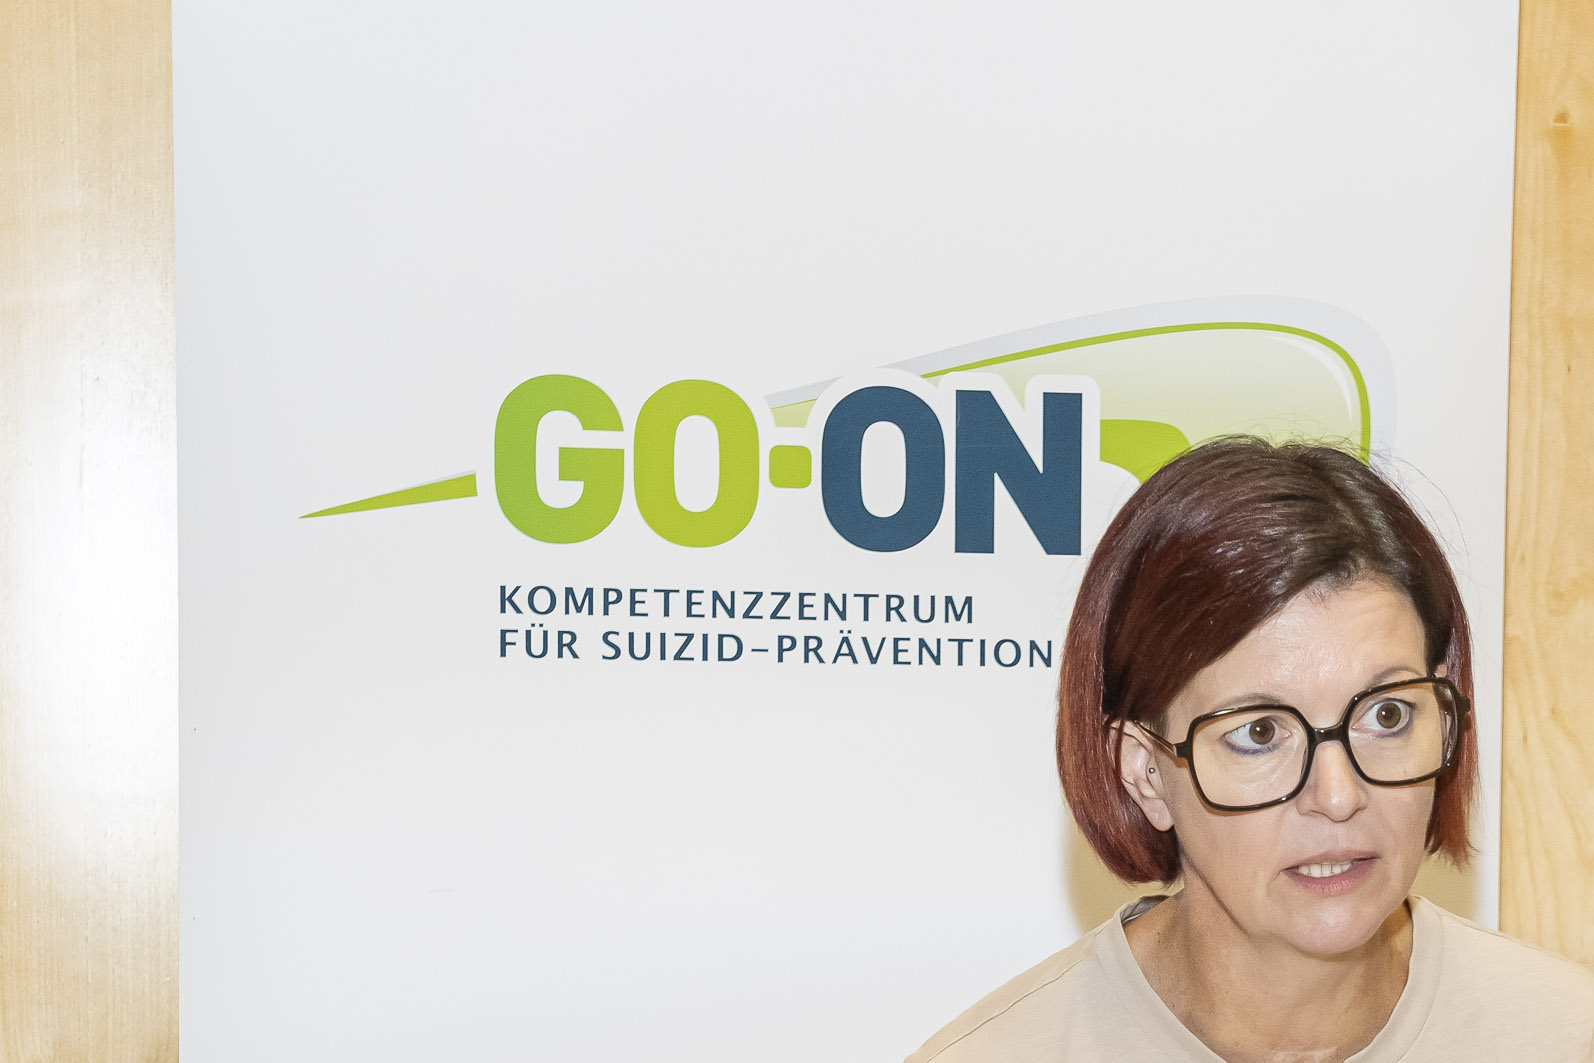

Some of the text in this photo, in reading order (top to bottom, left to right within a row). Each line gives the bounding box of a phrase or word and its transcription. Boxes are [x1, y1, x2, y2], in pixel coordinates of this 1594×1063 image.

[498, 585, 976, 624] KOMPETENZZENTRUM
[498, 626, 1054, 669] FÜR SUIZID-PRÄVENTION
